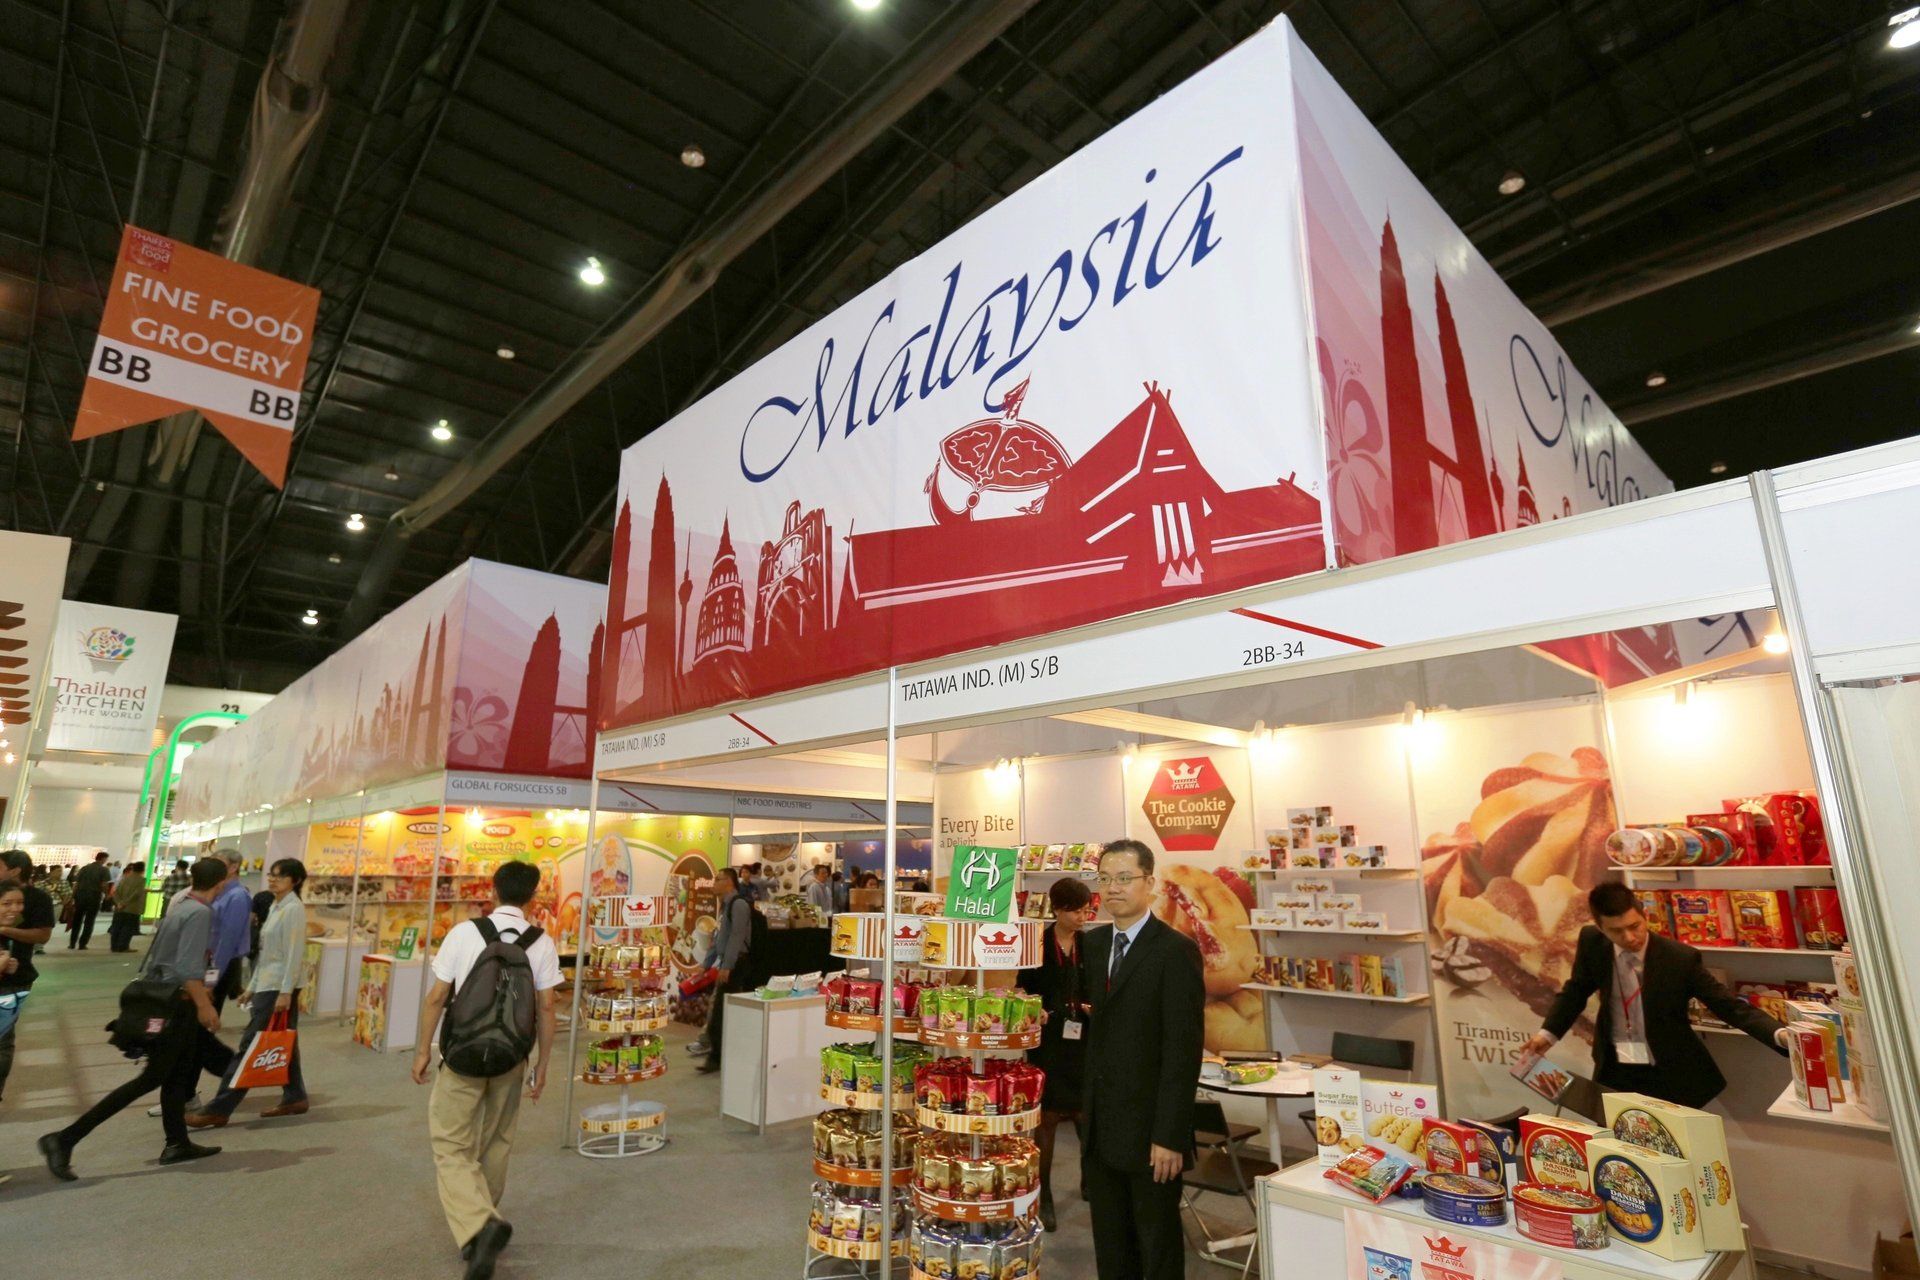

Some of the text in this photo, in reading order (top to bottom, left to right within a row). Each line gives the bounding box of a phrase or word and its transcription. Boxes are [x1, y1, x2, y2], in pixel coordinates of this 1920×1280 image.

[122, 271, 303, 345] FINE FOOD
[740, 146, 1243, 482] Malaysia
[131, 317, 291, 380] GROCERY
[98, 346, 294, 421] BB BB
[1243, 641, 1304, 666] 2BB-34
[53, 676, 147, 700] Thailand
[902, 655, 1059, 702] TATAWA IND. (M) S/B
[72, 708, 95, 717] THE
[99, 709, 142, 720] WORLD
[602, 732, 666, 756] TATAWA IND. (M) S/B
[728, 737, 750, 750] 2BB-34
[452, 779, 491, 791] GLOBAL
[494, 782, 554, 795] FORSUCCESS
[1171, 782, 1200, 790] TATAWA
[737, 798, 812, 810] NBC FOOD INDUSTRIES
[1149, 797, 1226, 814] The Cookie
[940, 814, 1014, 837] Every Bite
[1156, 813, 1222, 830] Company
[955, 896, 996, 917] Halal
[1453, 1021, 1531, 1043] Tiramisu
[1455, 1037, 1521, 1066] Twis
[1318, 1092, 1339, 1101] Sugar
[1364, 1099, 1411, 1116] Butter
[1610, 1189, 1645, 1207] DANISH
[1430, 1255, 1465, 1269] TATAWA
